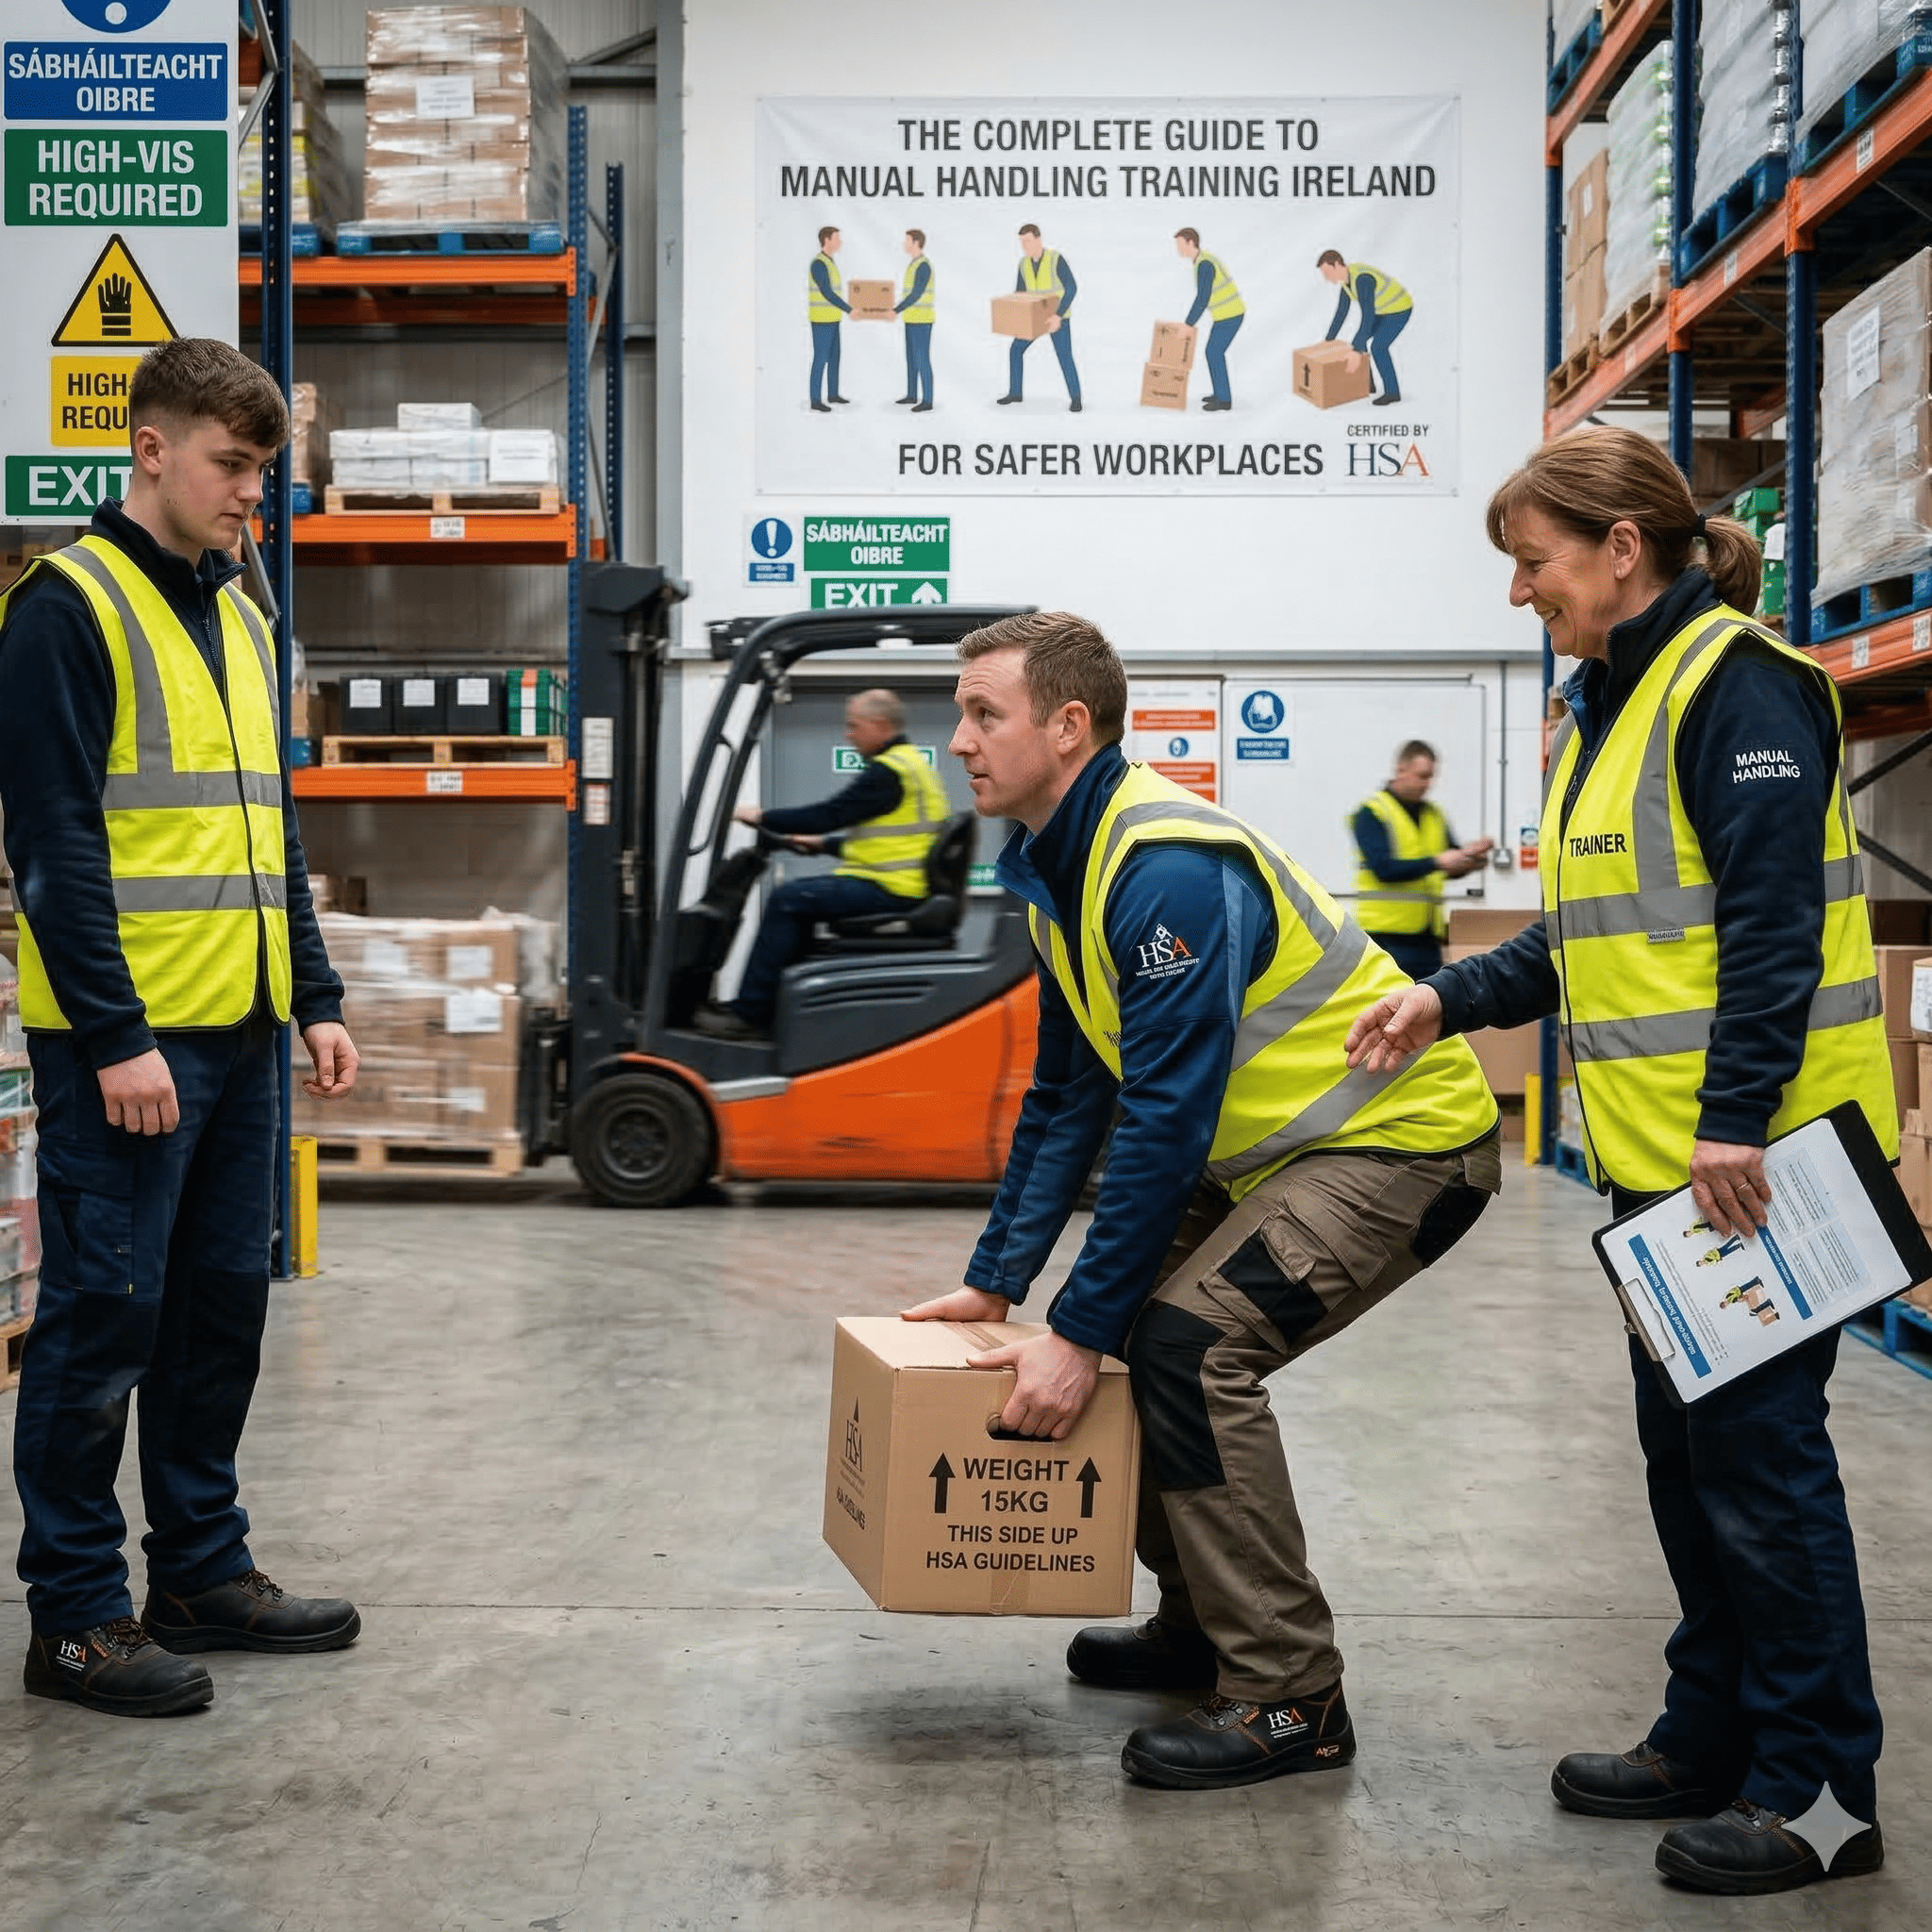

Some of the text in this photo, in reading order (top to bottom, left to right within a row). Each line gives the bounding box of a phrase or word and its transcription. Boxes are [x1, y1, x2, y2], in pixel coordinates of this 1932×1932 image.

[8, 47, 223, 80] SÁBHÁILTEACHT
[76, 87, 156, 112] OIBRE
[898, 120, 1320, 151] THE COMPLETE GUIDE TO
[38, 141, 195, 174] HIGH-VIS
[780, 165, 1436, 197] MANUAL HANDLING TRAINING IRELAND
[29, 183, 203, 219] REQUIRED
[62, 406, 128, 431] REQU
[1347, 425, 1429, 437] CERTIFIED BY
[899, 444, 1324, 476] FOR SAFER WORKPLACES
[1344, 442, 1430, 476] HSA
[28, 466, 133, 506] EXIT
[806, 520, 949, 543] SÁBHÁILTEACHT
[851, 546, 905, 565] OIBRE
[824, 583, 899, 608] EXIT
[1736, 750, 1794, 768] MANUAL
[1732, 765, 1802, 784] HANDLING
[1569, 833, 1628, 858] TRAINER
[1137, 937, 1192, 968] HSA
[963, 1457, 1070, 1482] WEIGHT
[981, 1491, 1049, 1513] 15KG
[947, 1524, 1078, 1545] THIS SIDE UP
[926, 1551, 1096, 1573] HSA GUIDELINES
[1267, 1707, 1303, 1729] HSA
